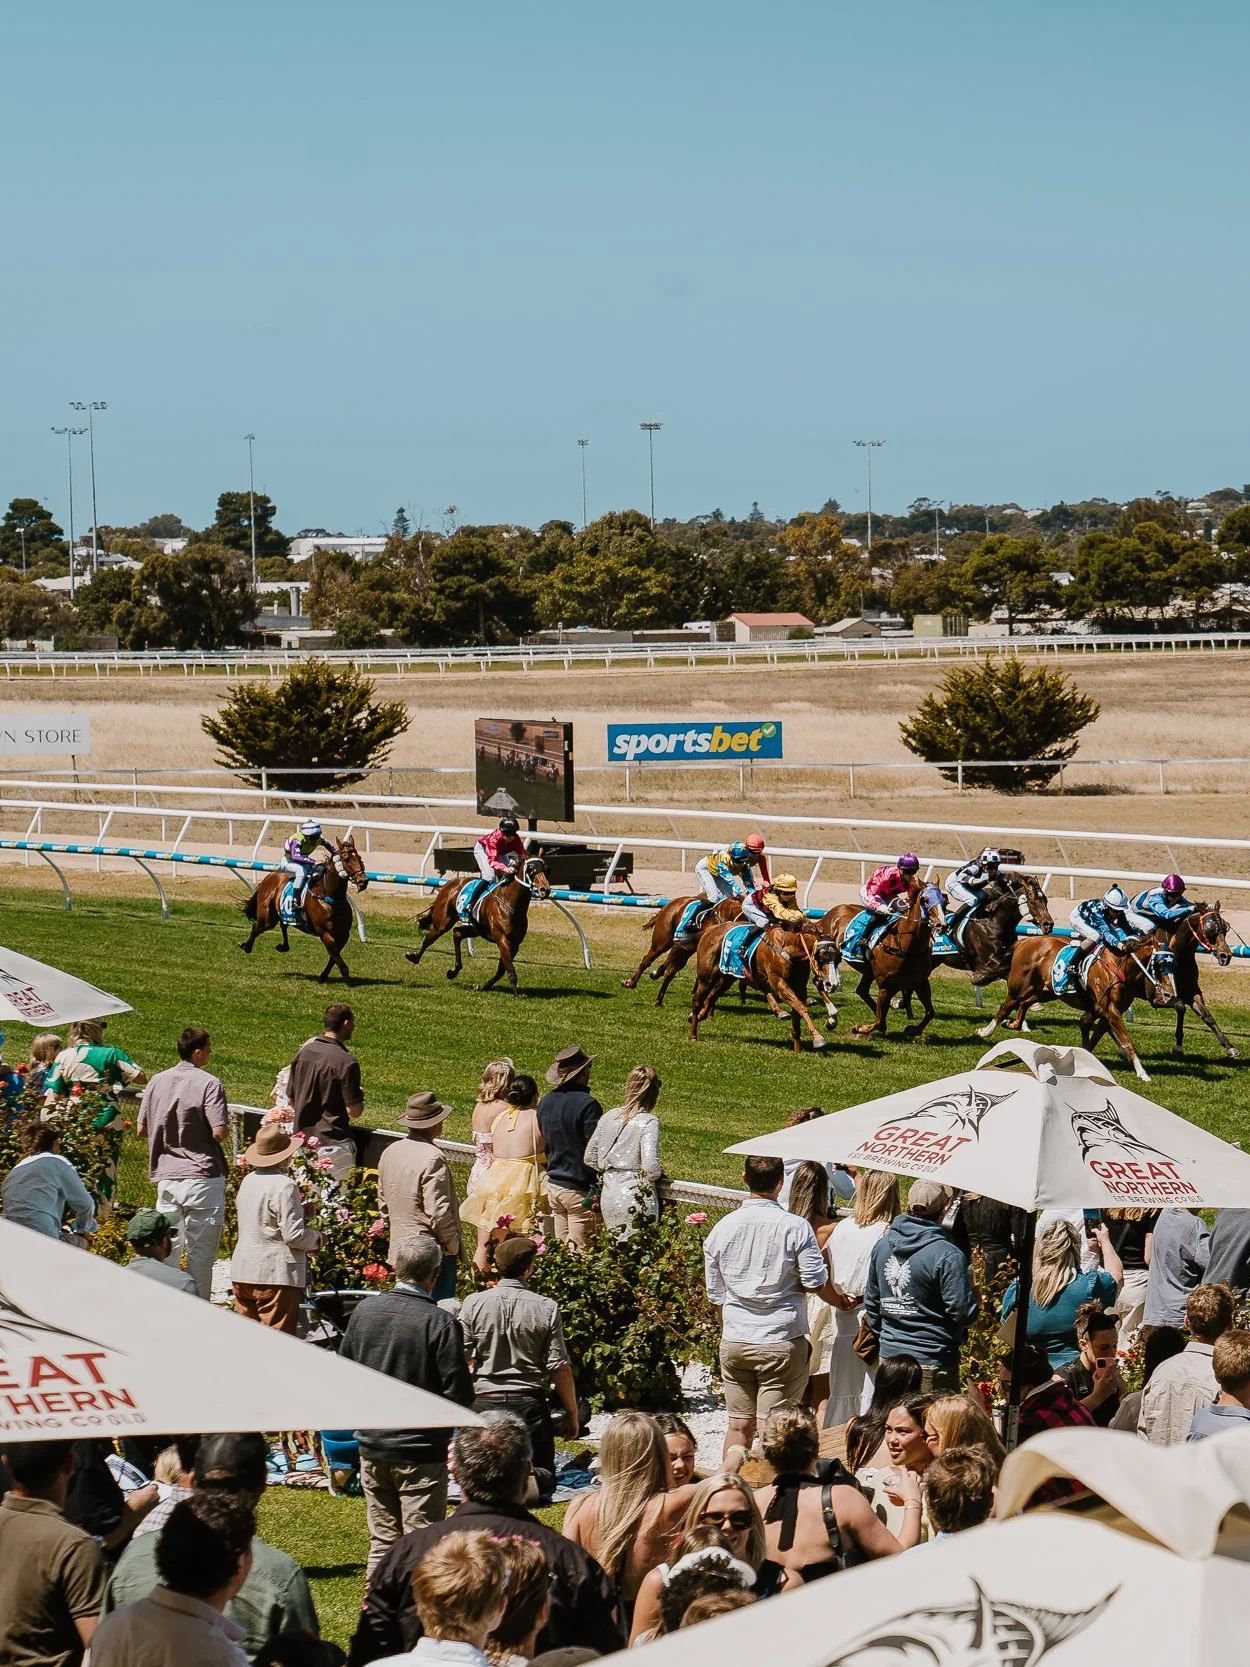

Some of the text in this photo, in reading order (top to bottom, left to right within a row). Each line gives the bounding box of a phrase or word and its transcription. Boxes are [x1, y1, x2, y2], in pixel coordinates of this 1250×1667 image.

[0, 729, 82, 743] N STORE
[612, 725, 763, 761] sportsbet
[873, 1126, 973, 1152] GREAT
[856, 1141, 952, 1166] NORTHERN
[863, 1154, 910, 1168] BREWING
[1089, 1160, 1181, 1179] GREAT
[1102, 1180, 1198, 1195] NORTHERN
[1127, 1195, 1174, 1204] BREWING
[4, 1388, 138, 1415] HERN
